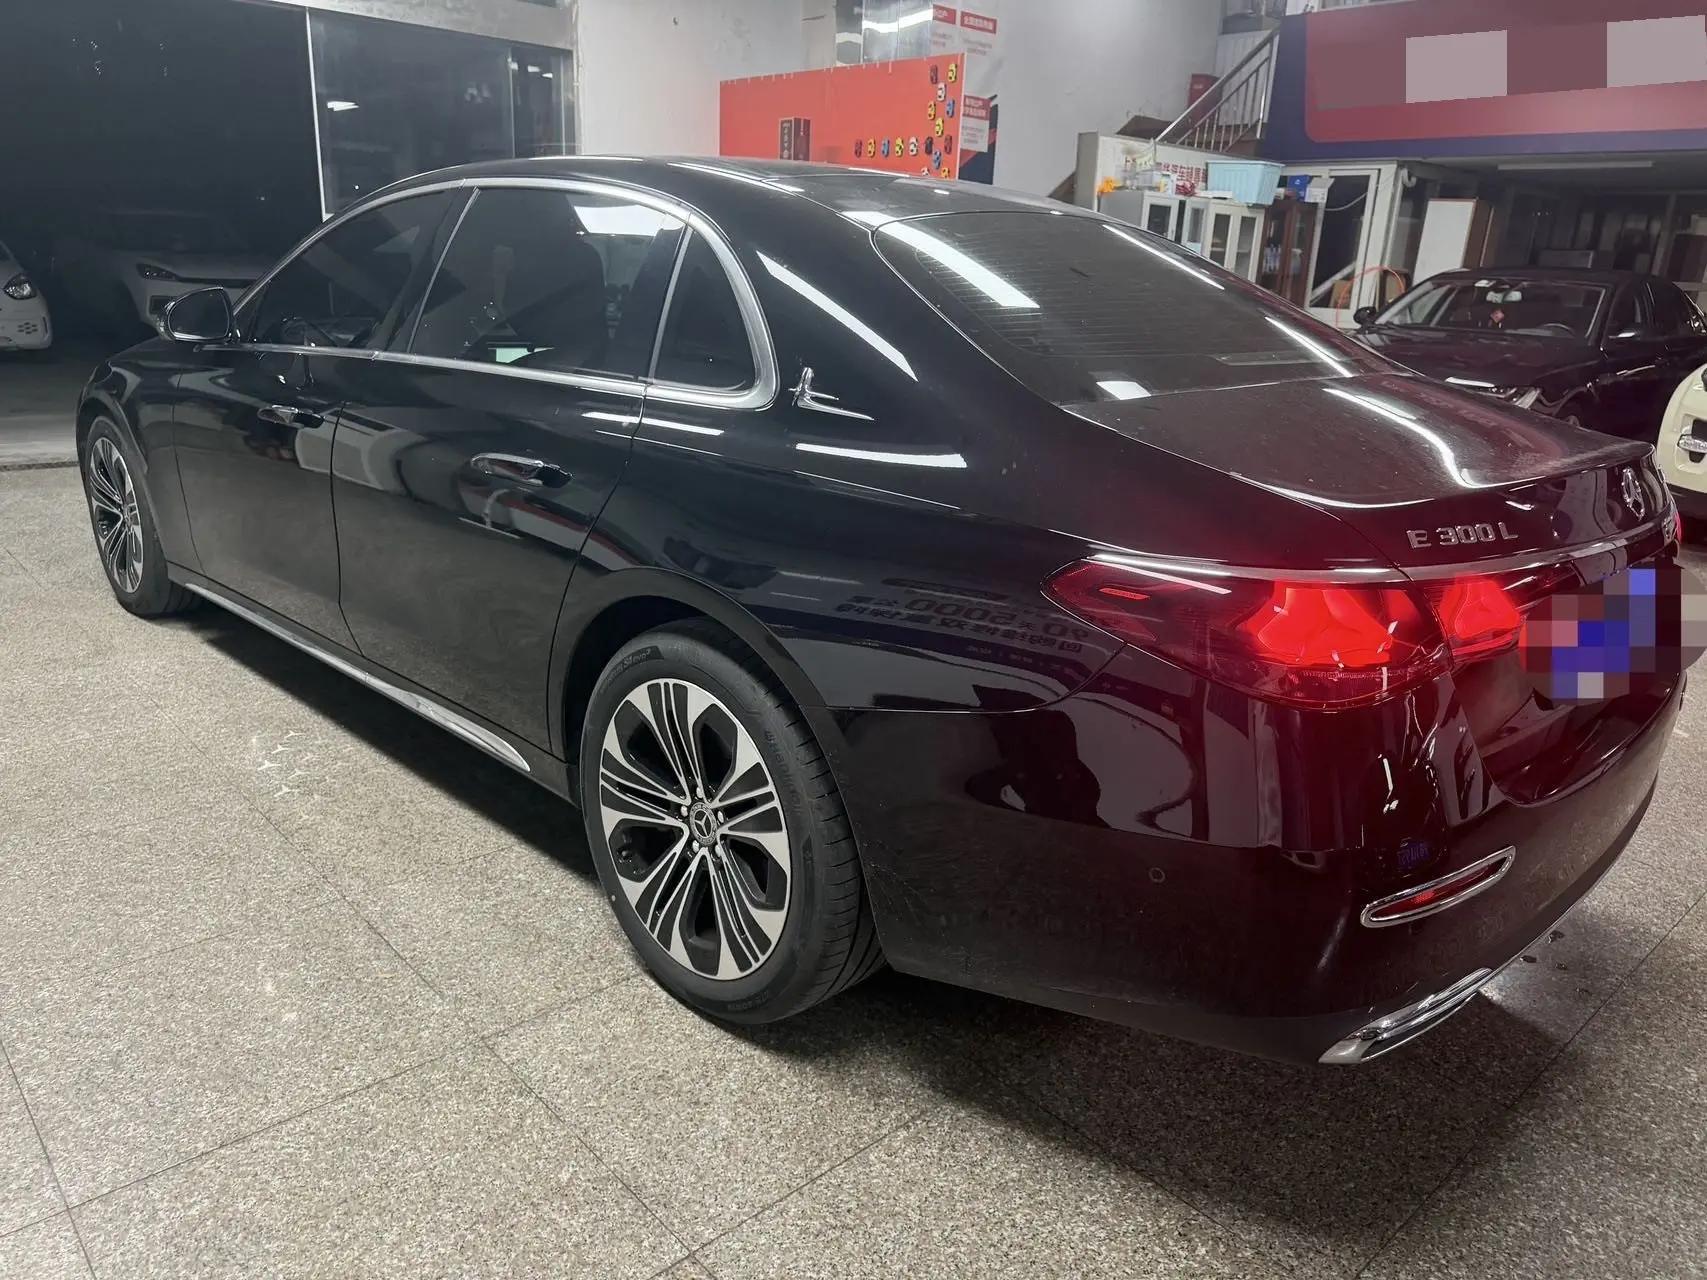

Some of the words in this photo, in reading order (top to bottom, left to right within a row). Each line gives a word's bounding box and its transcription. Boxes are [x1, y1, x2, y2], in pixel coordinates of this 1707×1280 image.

[1407, 530, 1431, 549] E
[1436, 524, 1496, 546] 300
[1499, 521, 1518, 540] L
